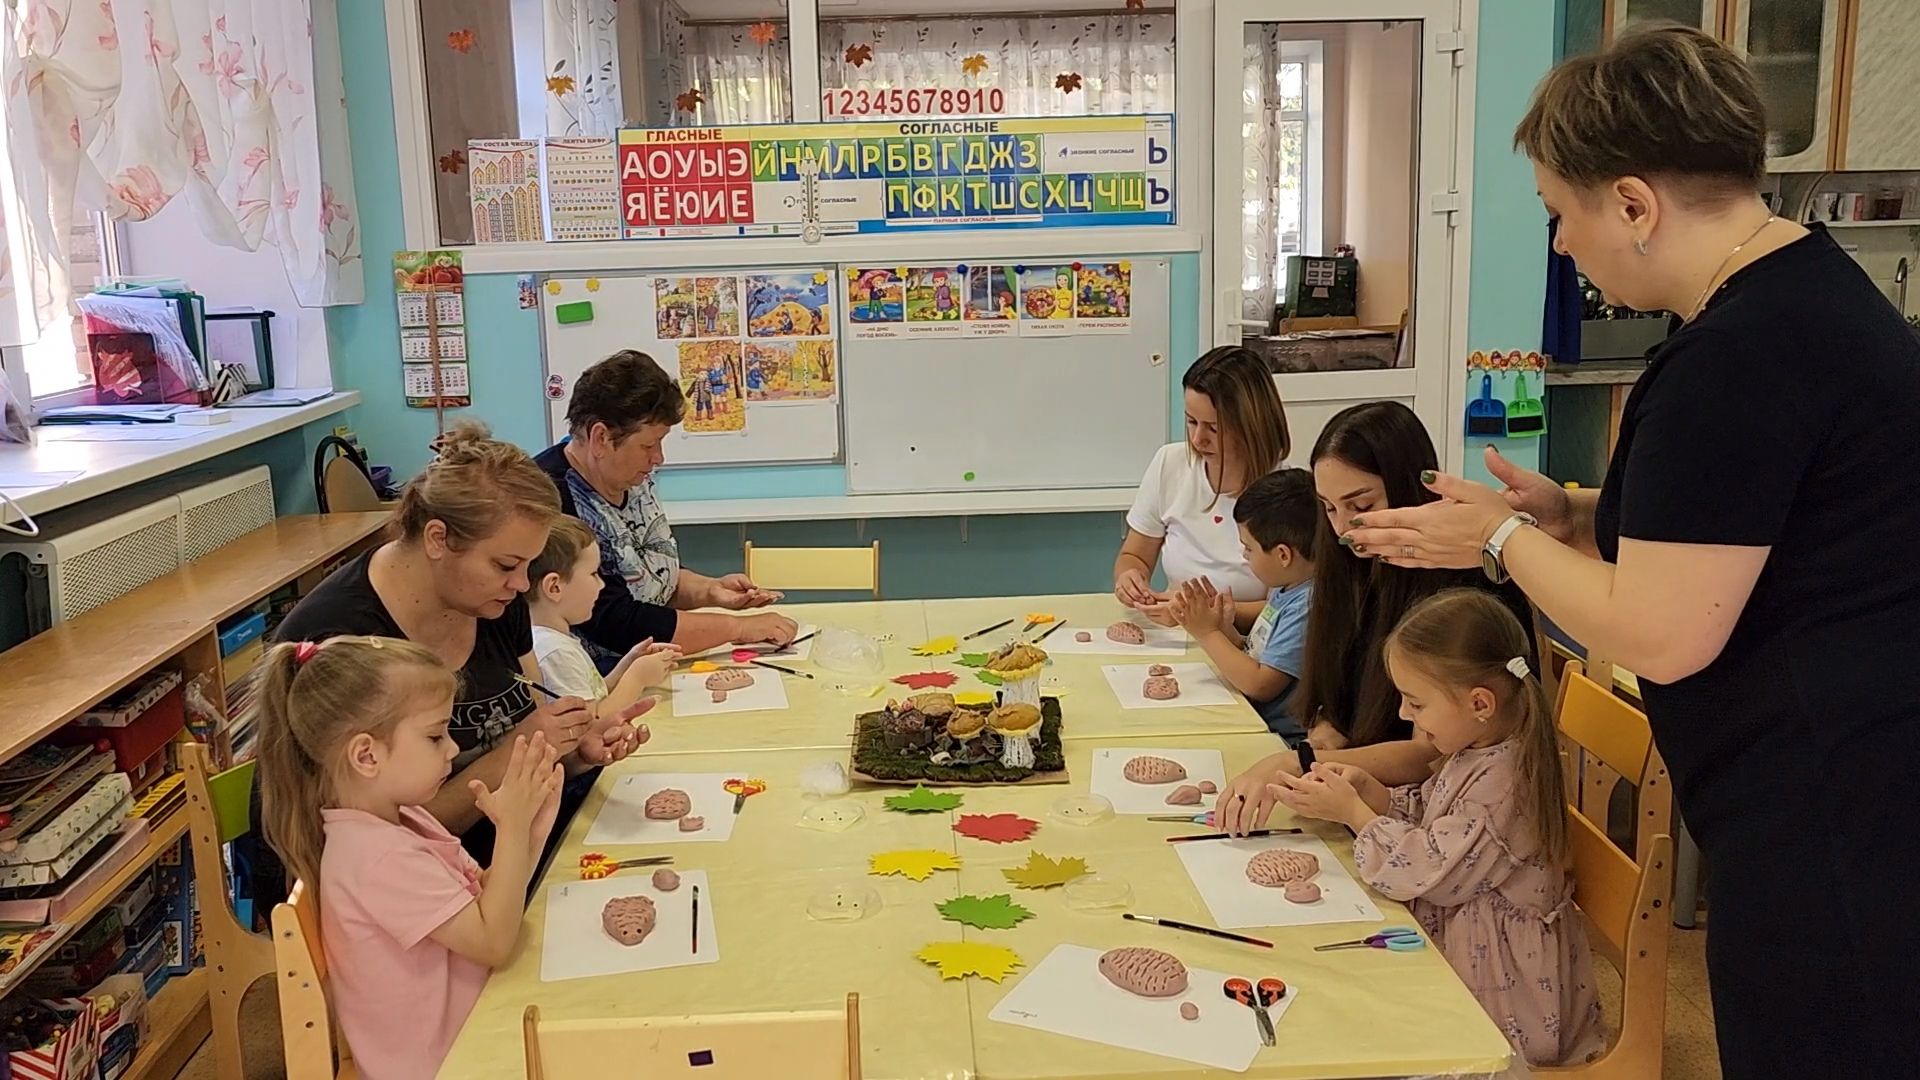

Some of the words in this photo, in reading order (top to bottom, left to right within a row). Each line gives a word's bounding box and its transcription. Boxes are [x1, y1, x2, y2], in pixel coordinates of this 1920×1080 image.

[646, 128, 723, 142] ГЛАСНЫЕ
[899, 121, 999, 135] СОГЛАСНЫЕ
[1148, 137, 1168, 164] Ь
[1147, 178, 1170, 205] Ъ
